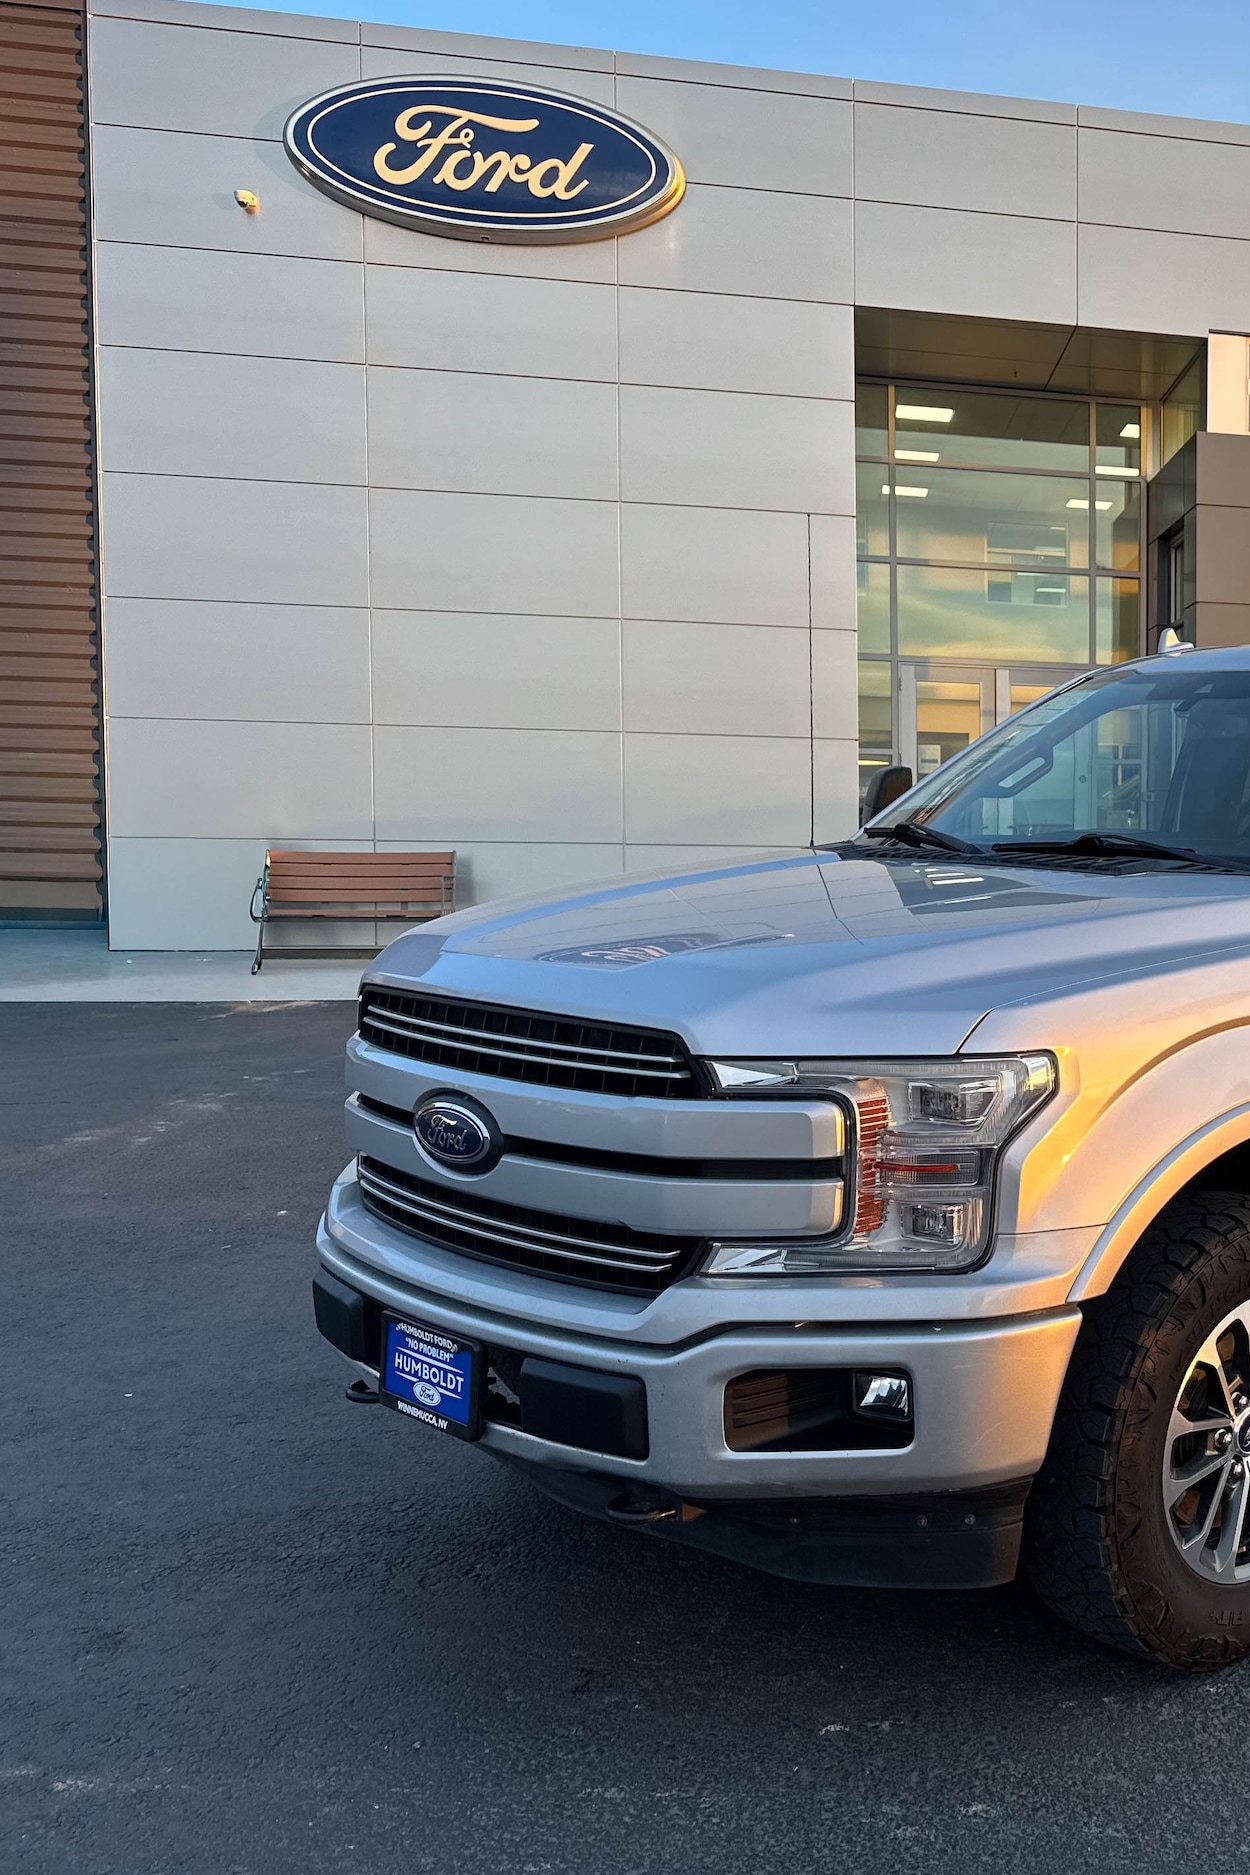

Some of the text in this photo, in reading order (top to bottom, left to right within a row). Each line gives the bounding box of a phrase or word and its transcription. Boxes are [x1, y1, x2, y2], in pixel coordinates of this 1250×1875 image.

[373, 104, 594, 201] Ford
[427, 1114, 468, 1151] Ford
[401, 1322, 453, 1350] HUMBOLDT FORD
[395, 1352, 464, 1392] HUMBOLDT
[419, 1385, 435, 1402] Ford
